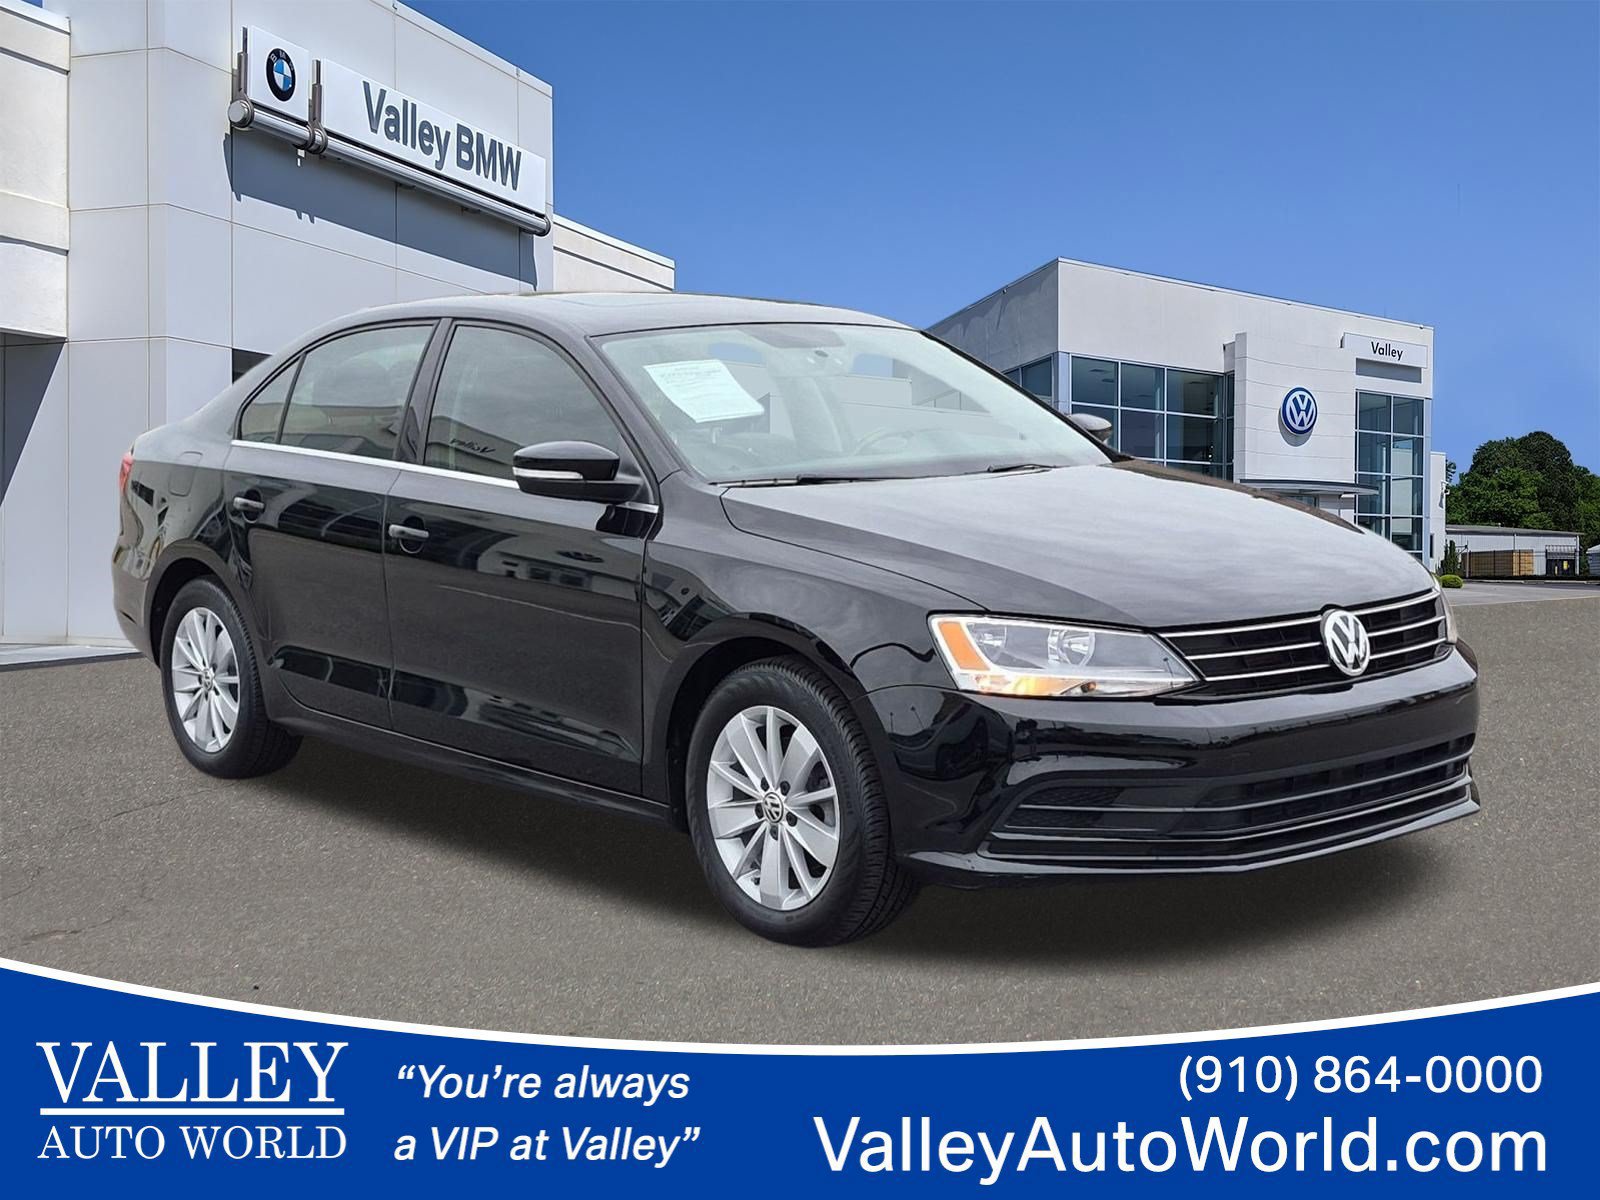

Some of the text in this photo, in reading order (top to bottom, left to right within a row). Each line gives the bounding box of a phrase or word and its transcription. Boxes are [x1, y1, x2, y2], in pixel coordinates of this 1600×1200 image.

[362, 80, 522, 191] Valley BMW
[1371, 341, 1404, 361] Valley
